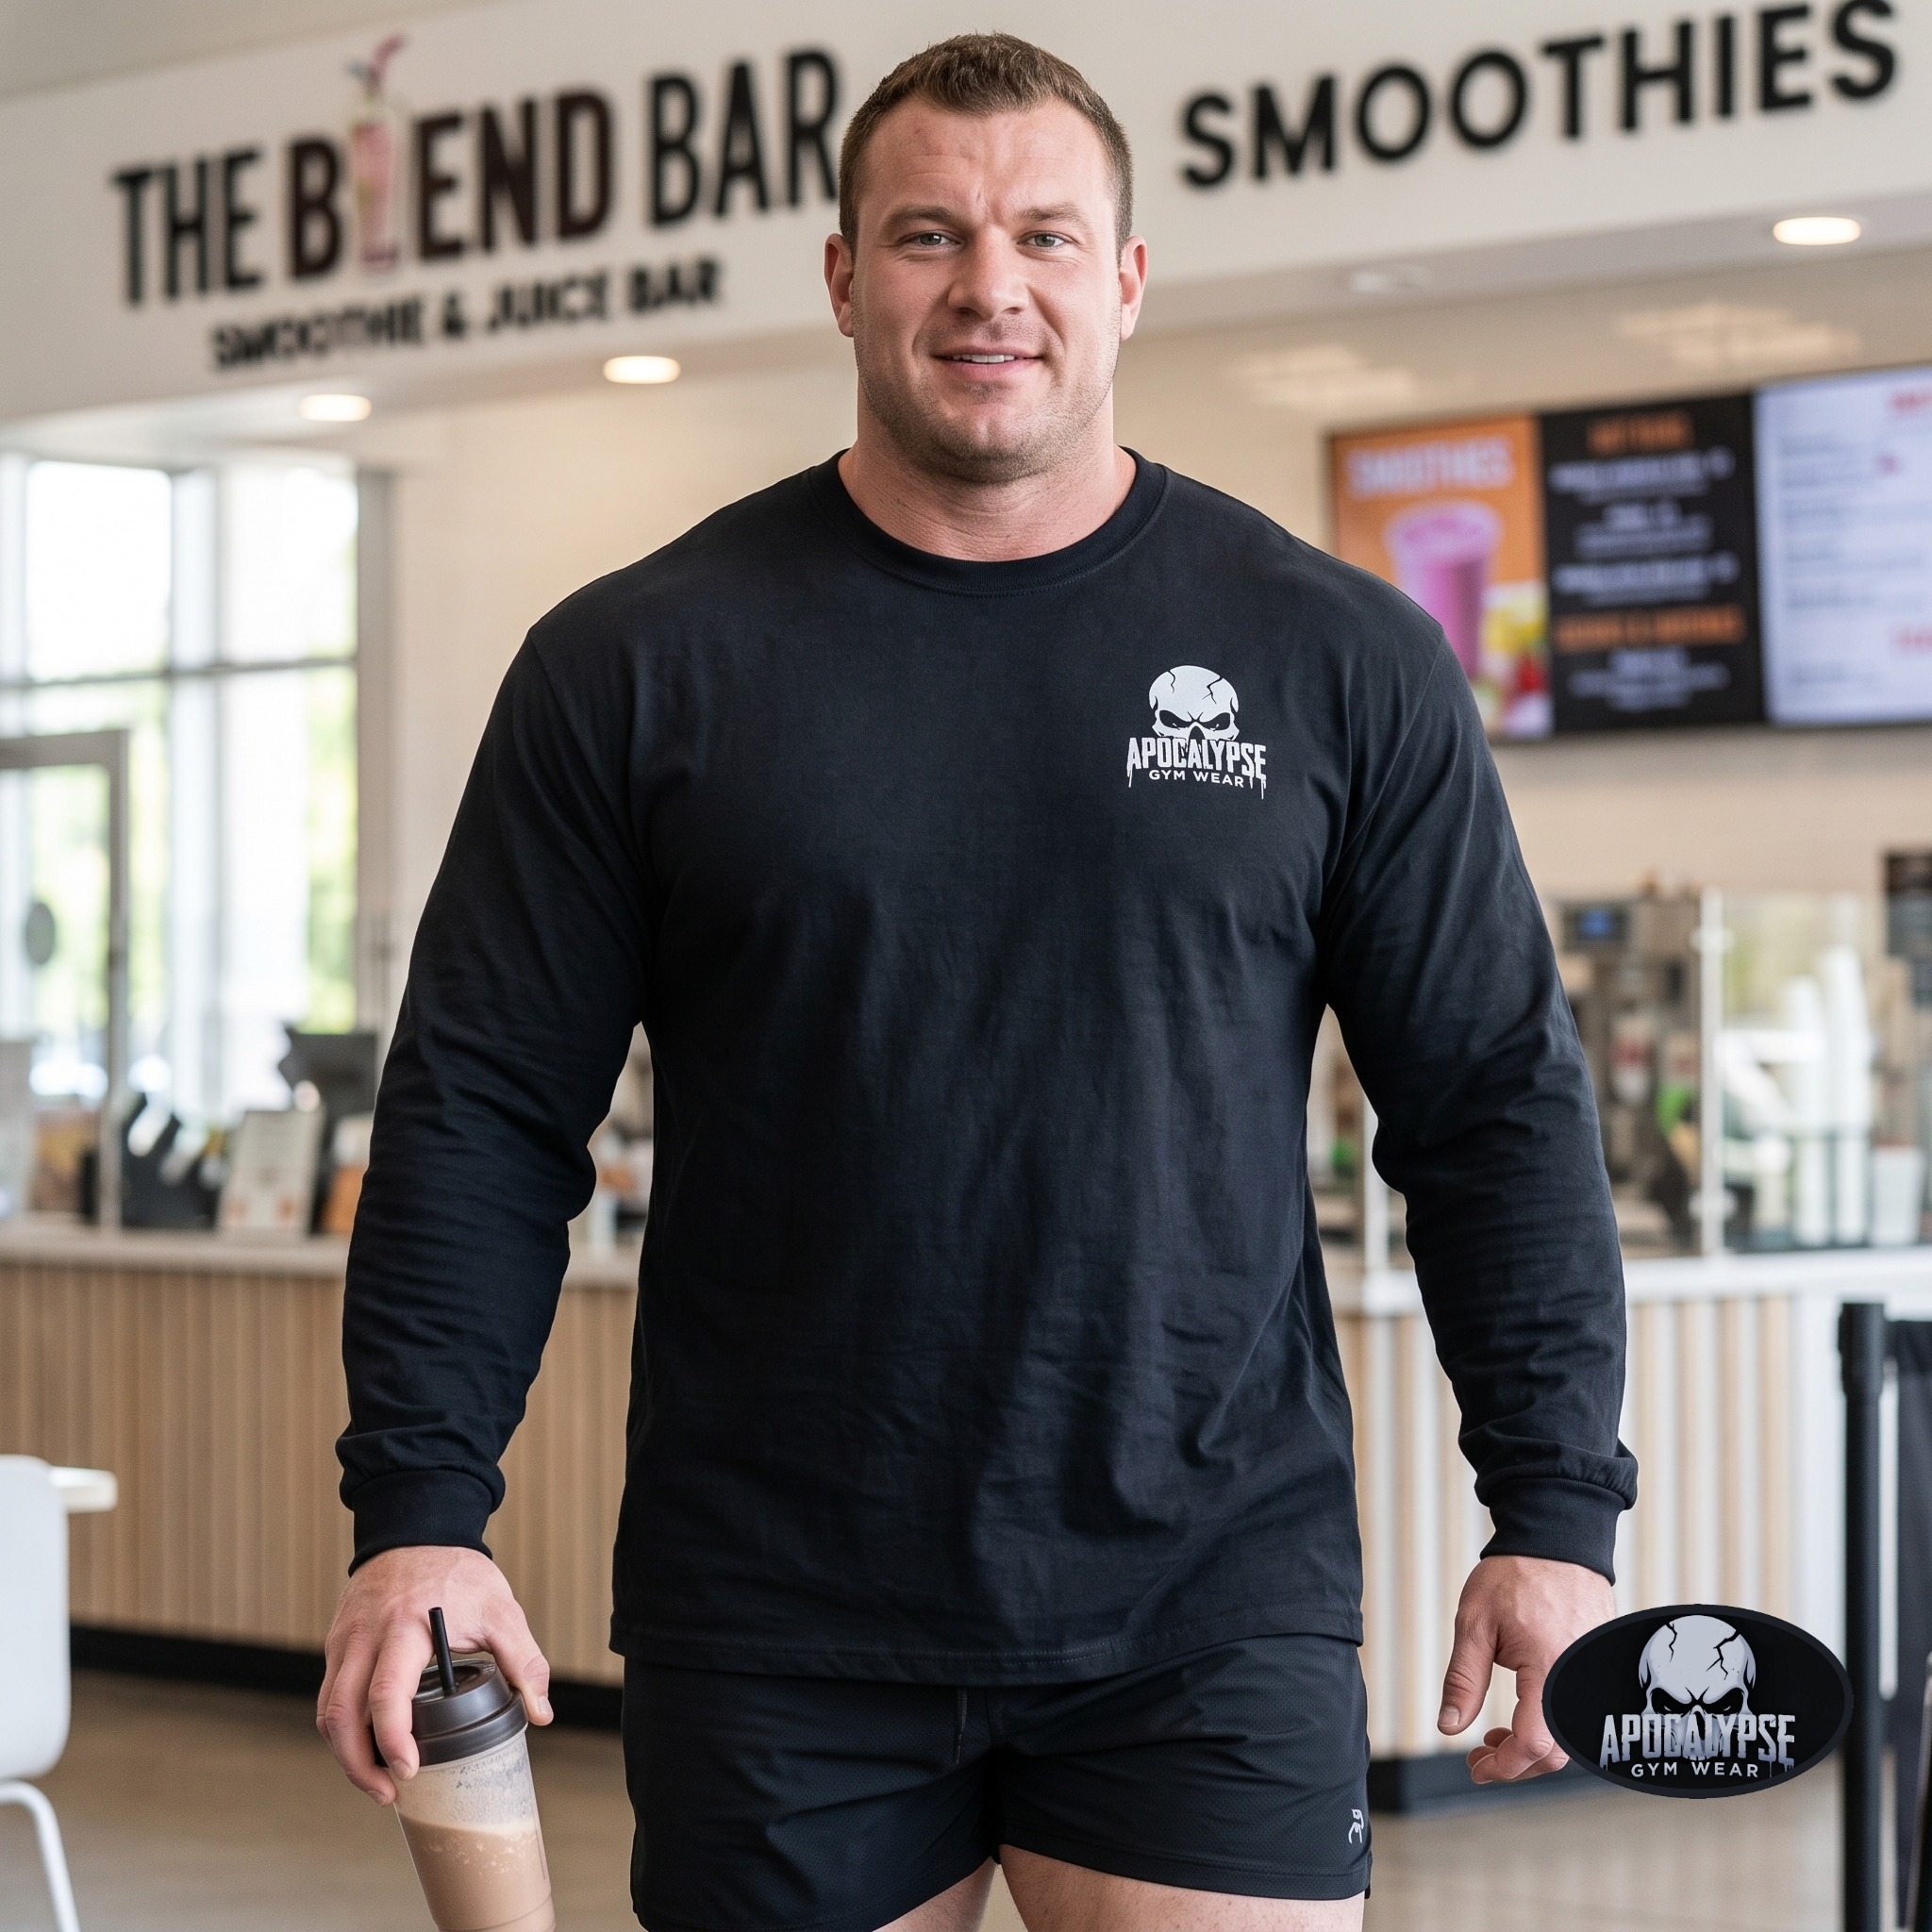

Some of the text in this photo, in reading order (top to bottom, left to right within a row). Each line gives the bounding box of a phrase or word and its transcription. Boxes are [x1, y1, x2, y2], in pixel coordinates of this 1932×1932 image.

[1179, 0, 1900, 191] SMOOTHIES
[111, 145, 266, 309] THE
[644, 46, 841, 229] BAR
[211, 255, 723, 371] SMOOTHIE & JUICE BAR
[1126, 737, 1267, 792] APOCALYPSE
[1148, 769, 1245, 789] GYM WEAR
